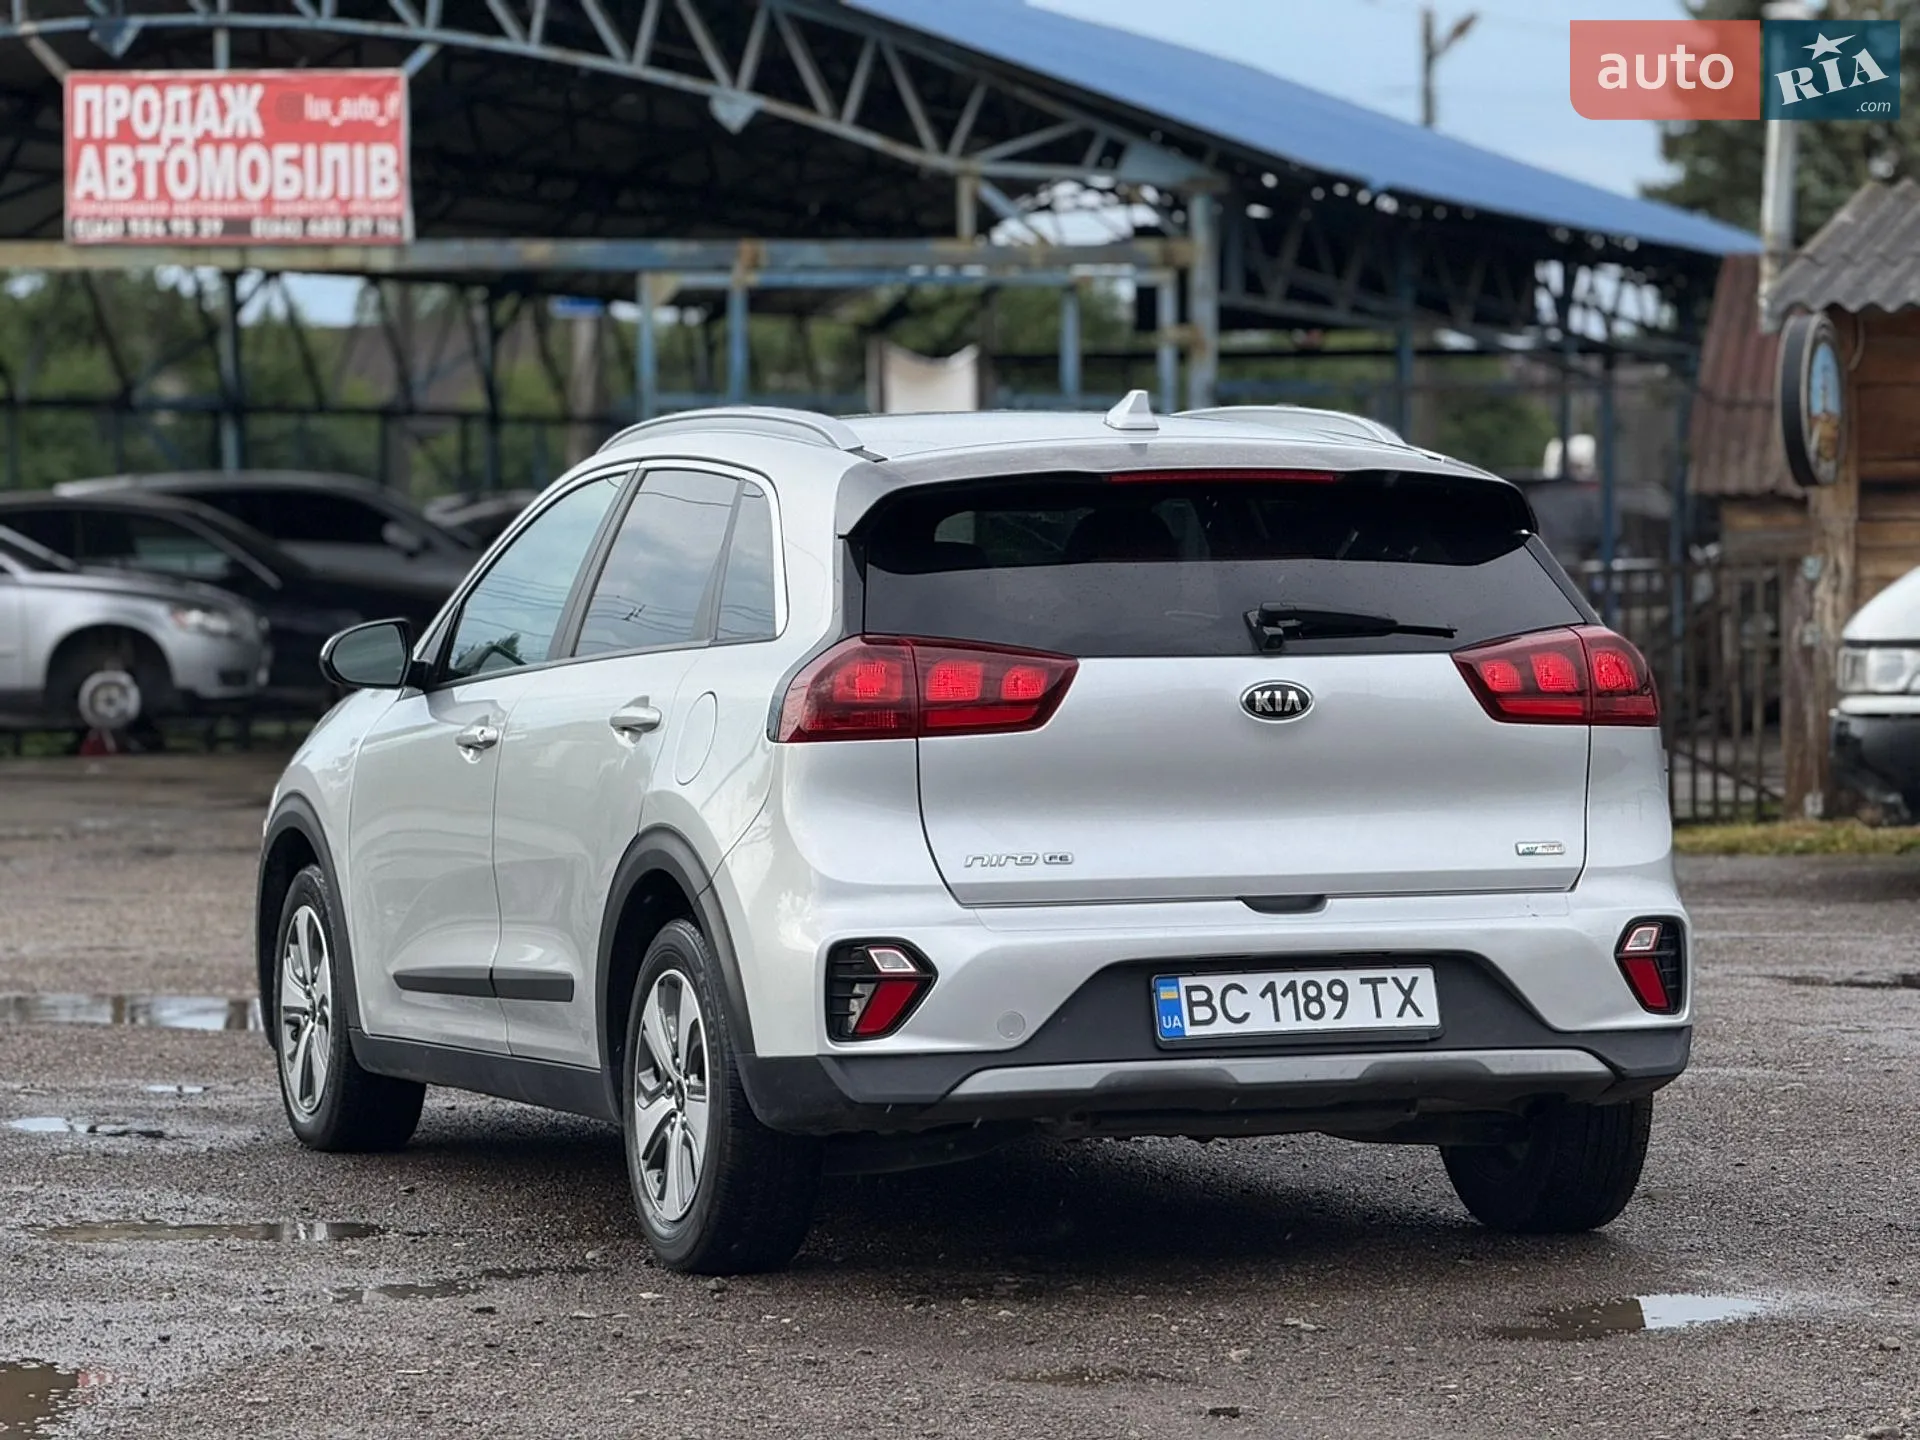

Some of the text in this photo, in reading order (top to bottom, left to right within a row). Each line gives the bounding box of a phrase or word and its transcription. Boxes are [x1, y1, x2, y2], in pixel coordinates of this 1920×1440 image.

[73, 83, 265, 147] ПРОДАЖ
[73, 143, 400, 200] АВТОМОБІЛІВ
[1254, 690, 1302, 711] KIA
[1162, 1015, 1183, 1029] UA
[1184, 976, 1424, 1027] BC 1189 TX
